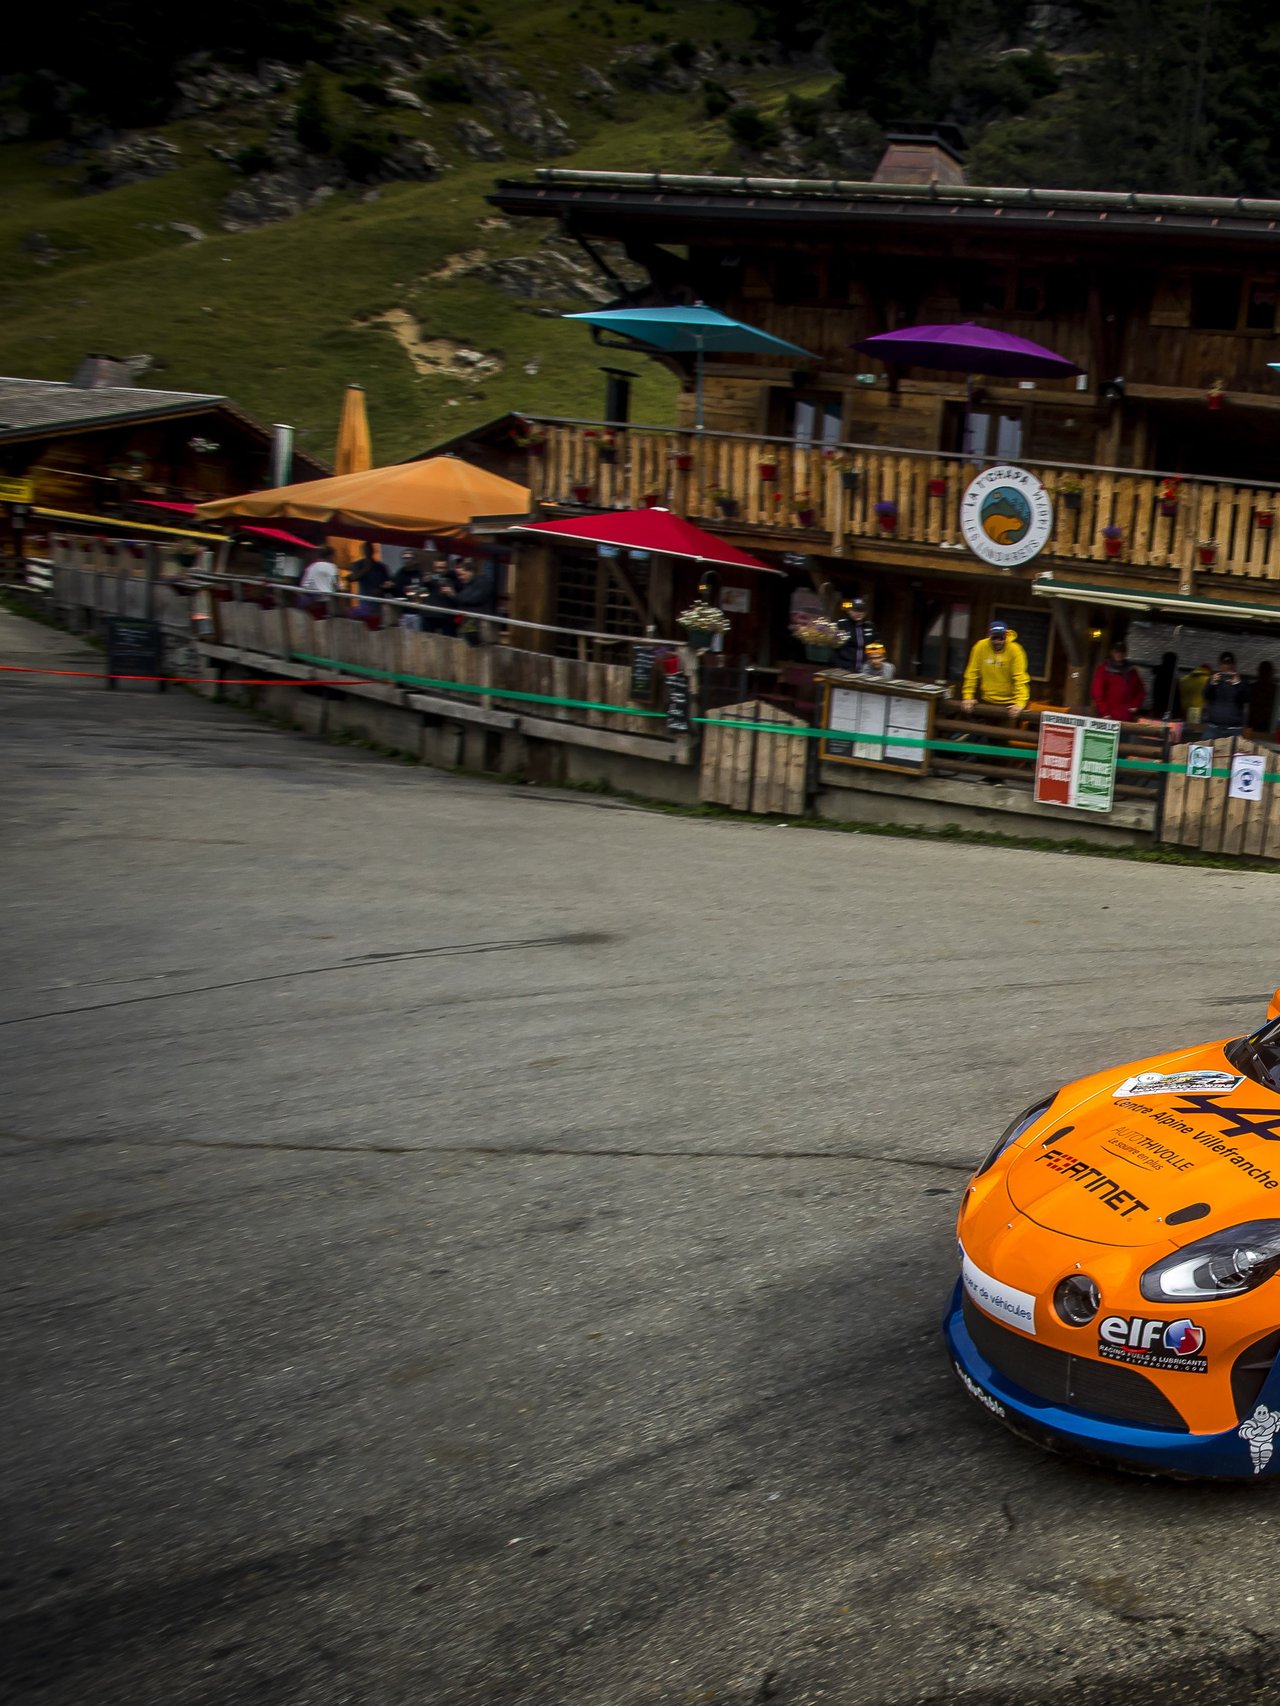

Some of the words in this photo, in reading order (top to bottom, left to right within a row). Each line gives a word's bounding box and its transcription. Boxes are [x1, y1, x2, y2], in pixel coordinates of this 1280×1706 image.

[1114, 1098, 1153, 1115] Centre
[1149, 1111, 1194, 1134] Alpine
[1192, 1131, 1278, 1190] Villefranche
[1147, 1157, 1164, 1171] plus
[1034, 1150, 1150, 1218] FORTINET
[990, 1295, 1032, 1321] véhicules
[1100, 1316, 1164, 1349] elf
[1098, 1344, 1126, 1357] RACING
[1126, 1350, 1151, 1361] FUELS
[1158, 1356, 1207, 1367] LUBRICANTS
